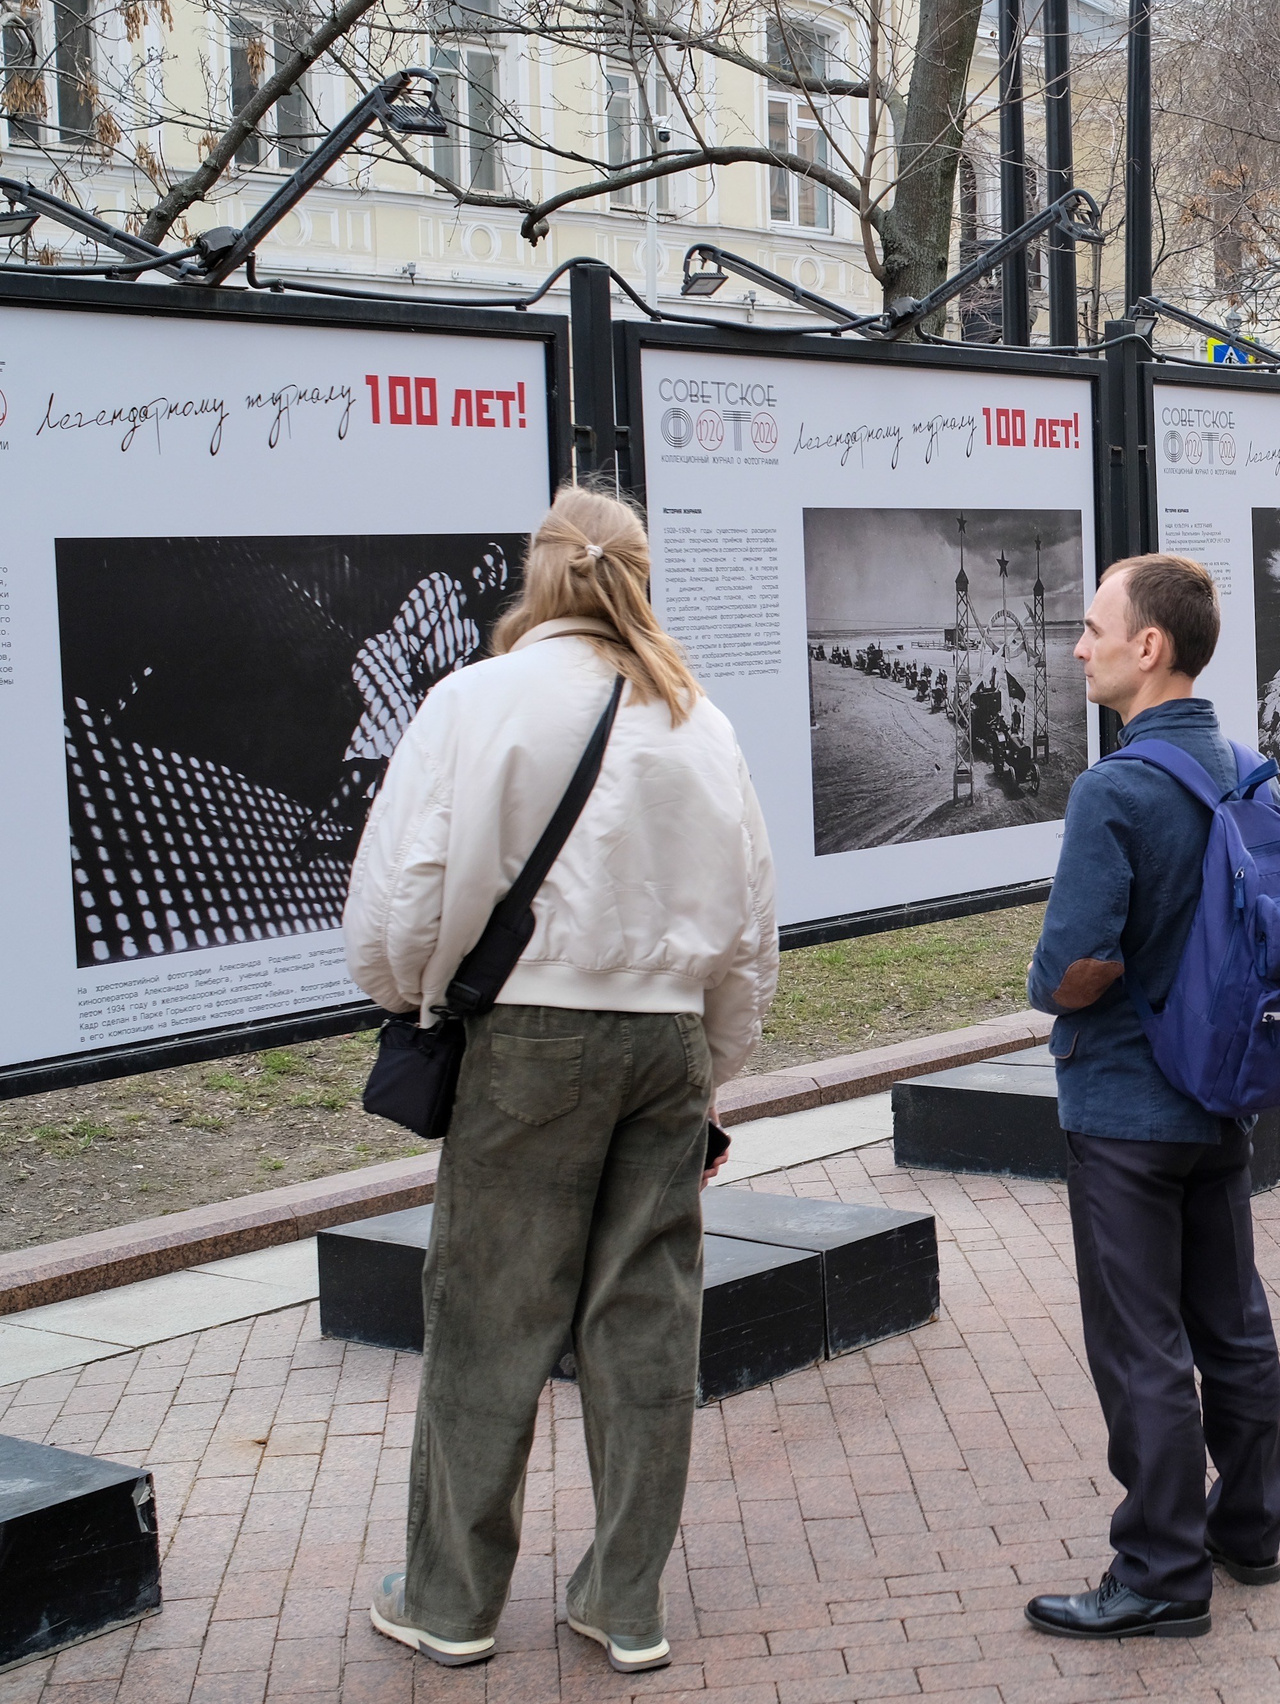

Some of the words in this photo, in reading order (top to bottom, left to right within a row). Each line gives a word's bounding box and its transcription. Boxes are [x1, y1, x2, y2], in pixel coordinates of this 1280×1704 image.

[366, 374, 438, 426] 100
[659, 378, 777, 407] СОВЕТСКОЕ
[982, 407, 1026, 446] 100
[1162, 407, 1235, 429] СОВЕТСКОЕ
[661, 455, 709, 464] КОЛЛЕКЦИОННЫЙ
[78, 991, 138, 1006] кинооператора
[145, 983, 189, 996] Александра
[195, 976, 232, 988] Лемберга,
[274, 962, 314, 974] Александра
[96, 975, 160, 992] хрестоматийной
[167, 968, 212, 981] фотографии
[219, 960, 261, 972] Александра
[268, 953, 302, 964] Родченко
[79, 1009, 102, 1019] летом
[107, 1004, 125, 1014] 1934
[130, 1001, 148, 1010] году
[162, 988, 226, 1004] железнодорожной
[230, 980, 275, 992] катастрофе.
[80, 1022, 98, 1031] Кадр
[102, 1017, 129, 1027] сделан
[141, 1011, 163, 1020] Парке
[166, 1004, 201, 1016] Горького
[216, 993, 262, 1008] фотоаппарат
[300, 980, 340, 992] Фотография
[108, 1023, 154, 1037] композицию
[171, 1014, 206, 1026] Выставке
[210, 1008, 244, 1019] мастеров
[248, 1000, 290, 1013] советского
[293, 990, 345, 1005] фотоискусства
